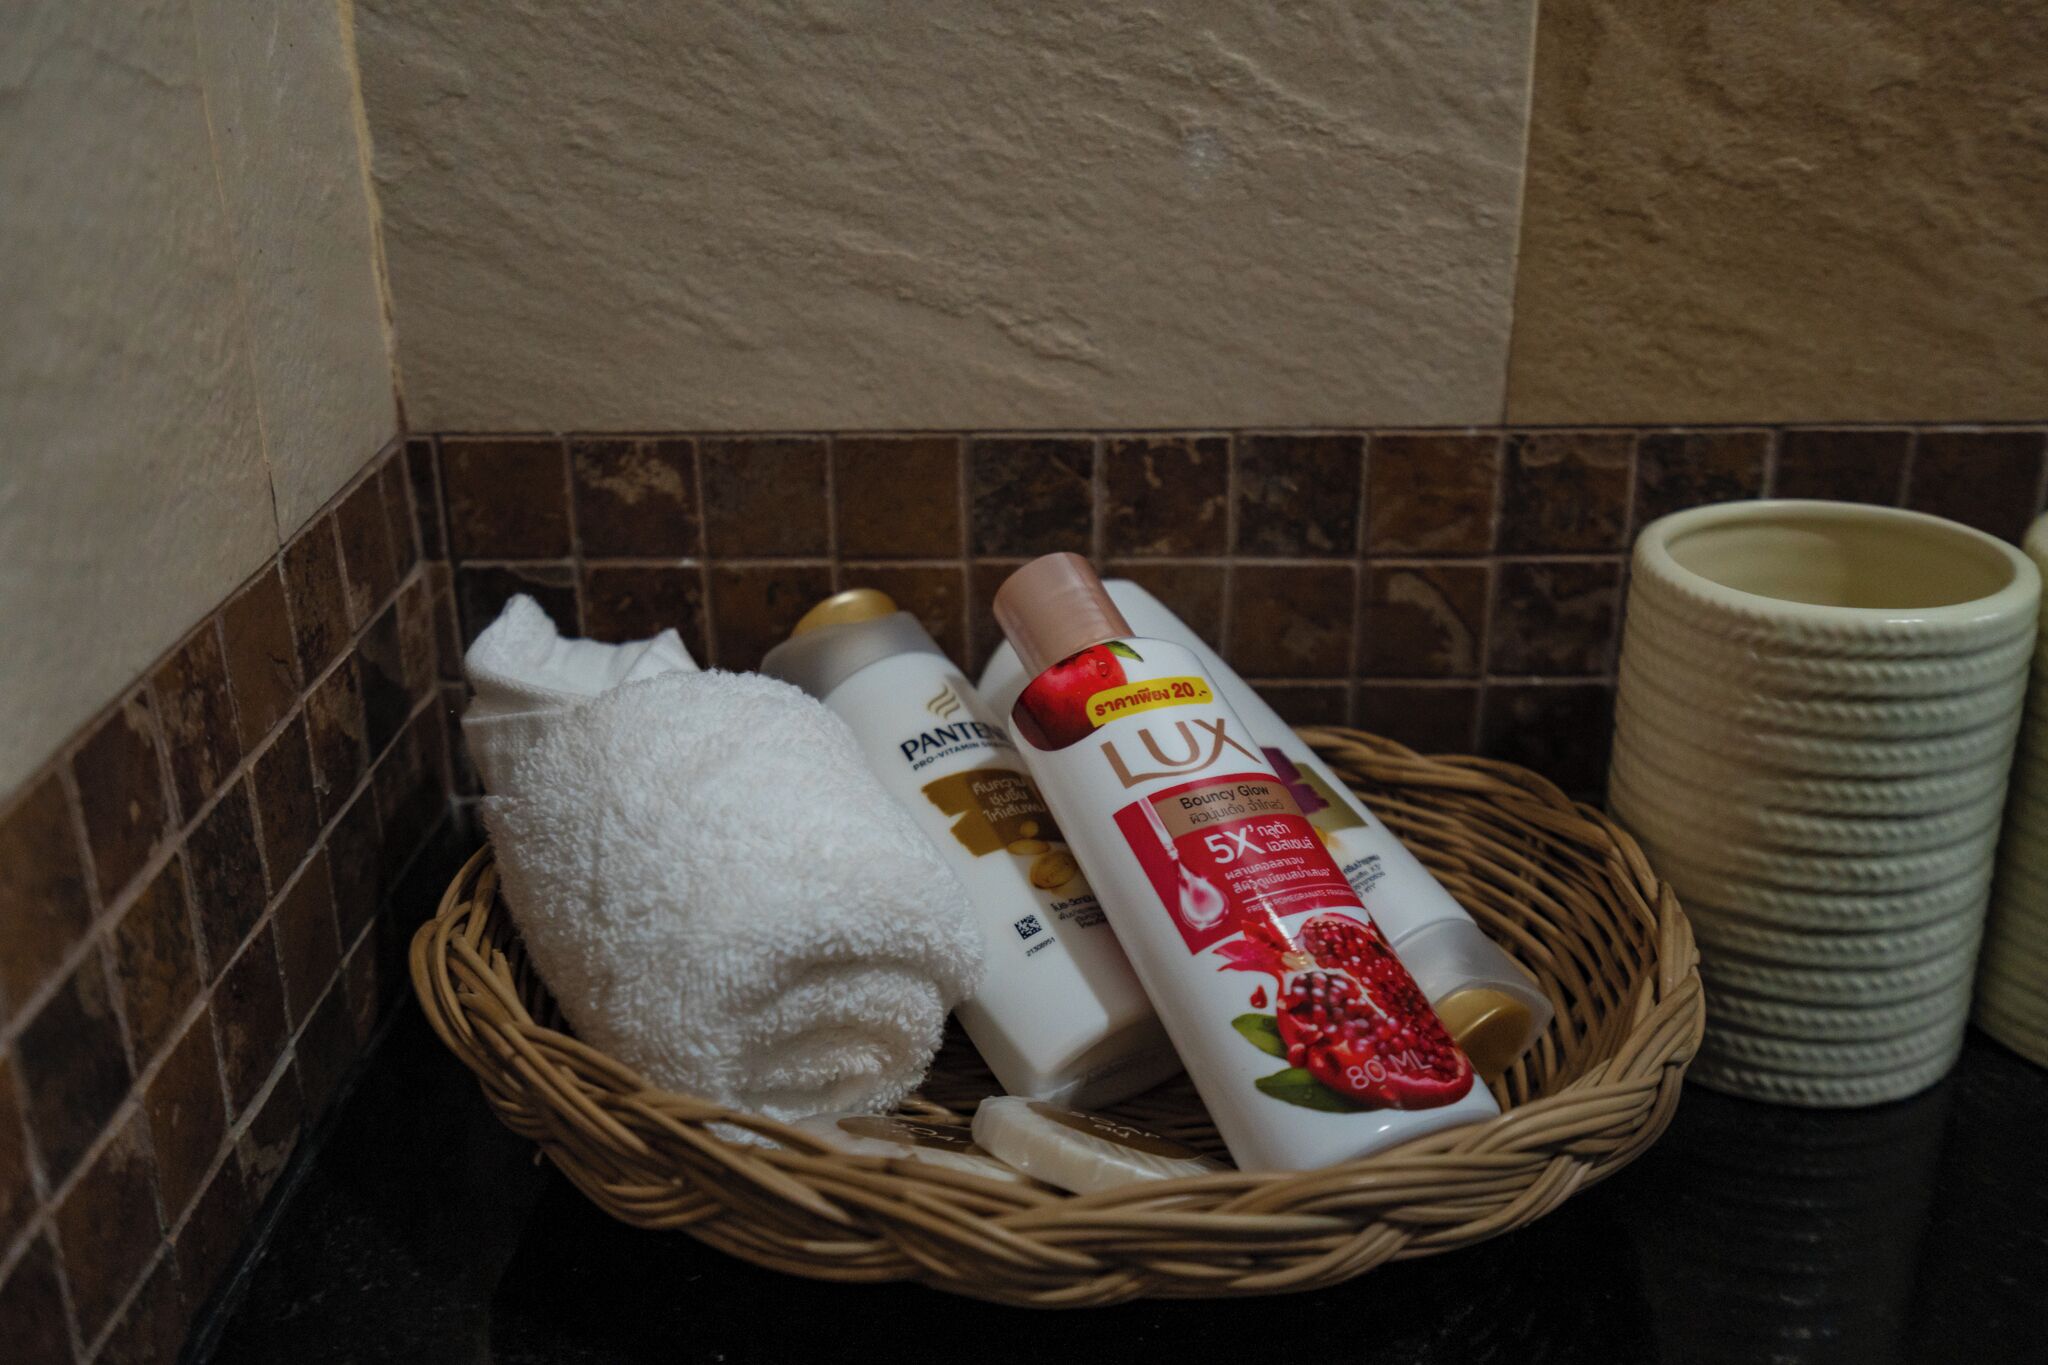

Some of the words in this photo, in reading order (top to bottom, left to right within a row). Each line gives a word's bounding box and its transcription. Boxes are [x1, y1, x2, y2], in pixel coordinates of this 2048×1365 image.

[1095, 687, 1170, 717] ราคาเพียง
[1100, 718, 1262, 789] LUX
[1179, 788, 1235, 810] Bouncy
[1238, 784, 1270, 797] Glow
[1189, 803, 1245, 825] ผิวนุ่มเด้ง
[1257, 821, 1291, 839] กลูต้า
[1224, 855, 1305, 880] ผสานคอลลาเจน
[1346, 1058, 1387, 1089] 80
[1388, 1048, 1432, 1075] ML
